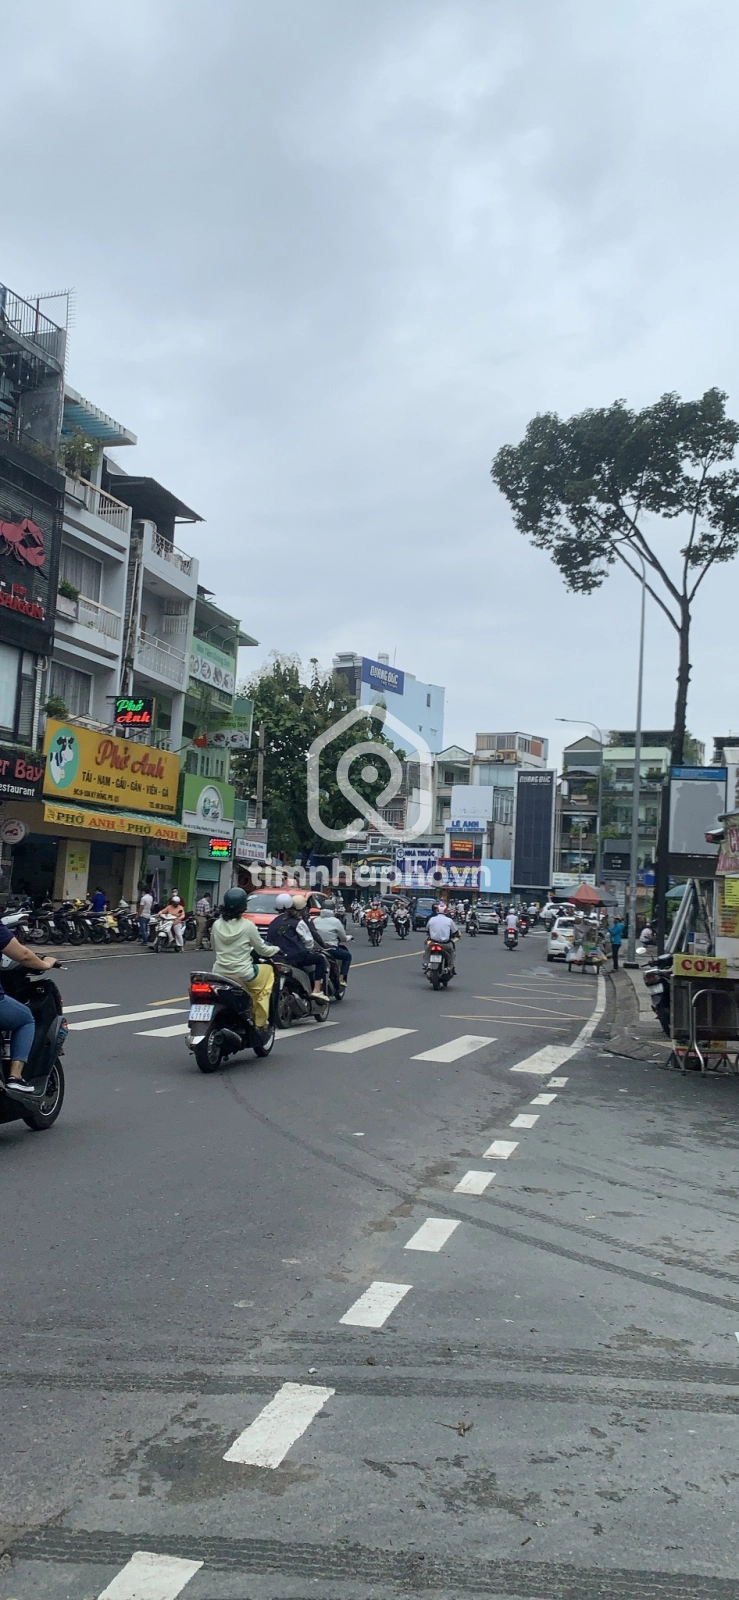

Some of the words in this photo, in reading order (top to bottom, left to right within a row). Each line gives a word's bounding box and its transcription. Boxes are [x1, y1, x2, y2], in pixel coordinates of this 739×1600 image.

[117, 699, 144, 713] Phở
[117, 712, 150, 723] Anh
[95, 739, 131, 771] Phở
[131, 753, 165, 779] Anh
[14, 758, 42, 781] Bay
[56, 811, 84, 824] PHỞ
[89, 817, 115, 829] ANH
[127, 821, 152, 834] PHỞ
[156, 827, 178, 839] ANH
[681, 958, 721, 973] CƠM
